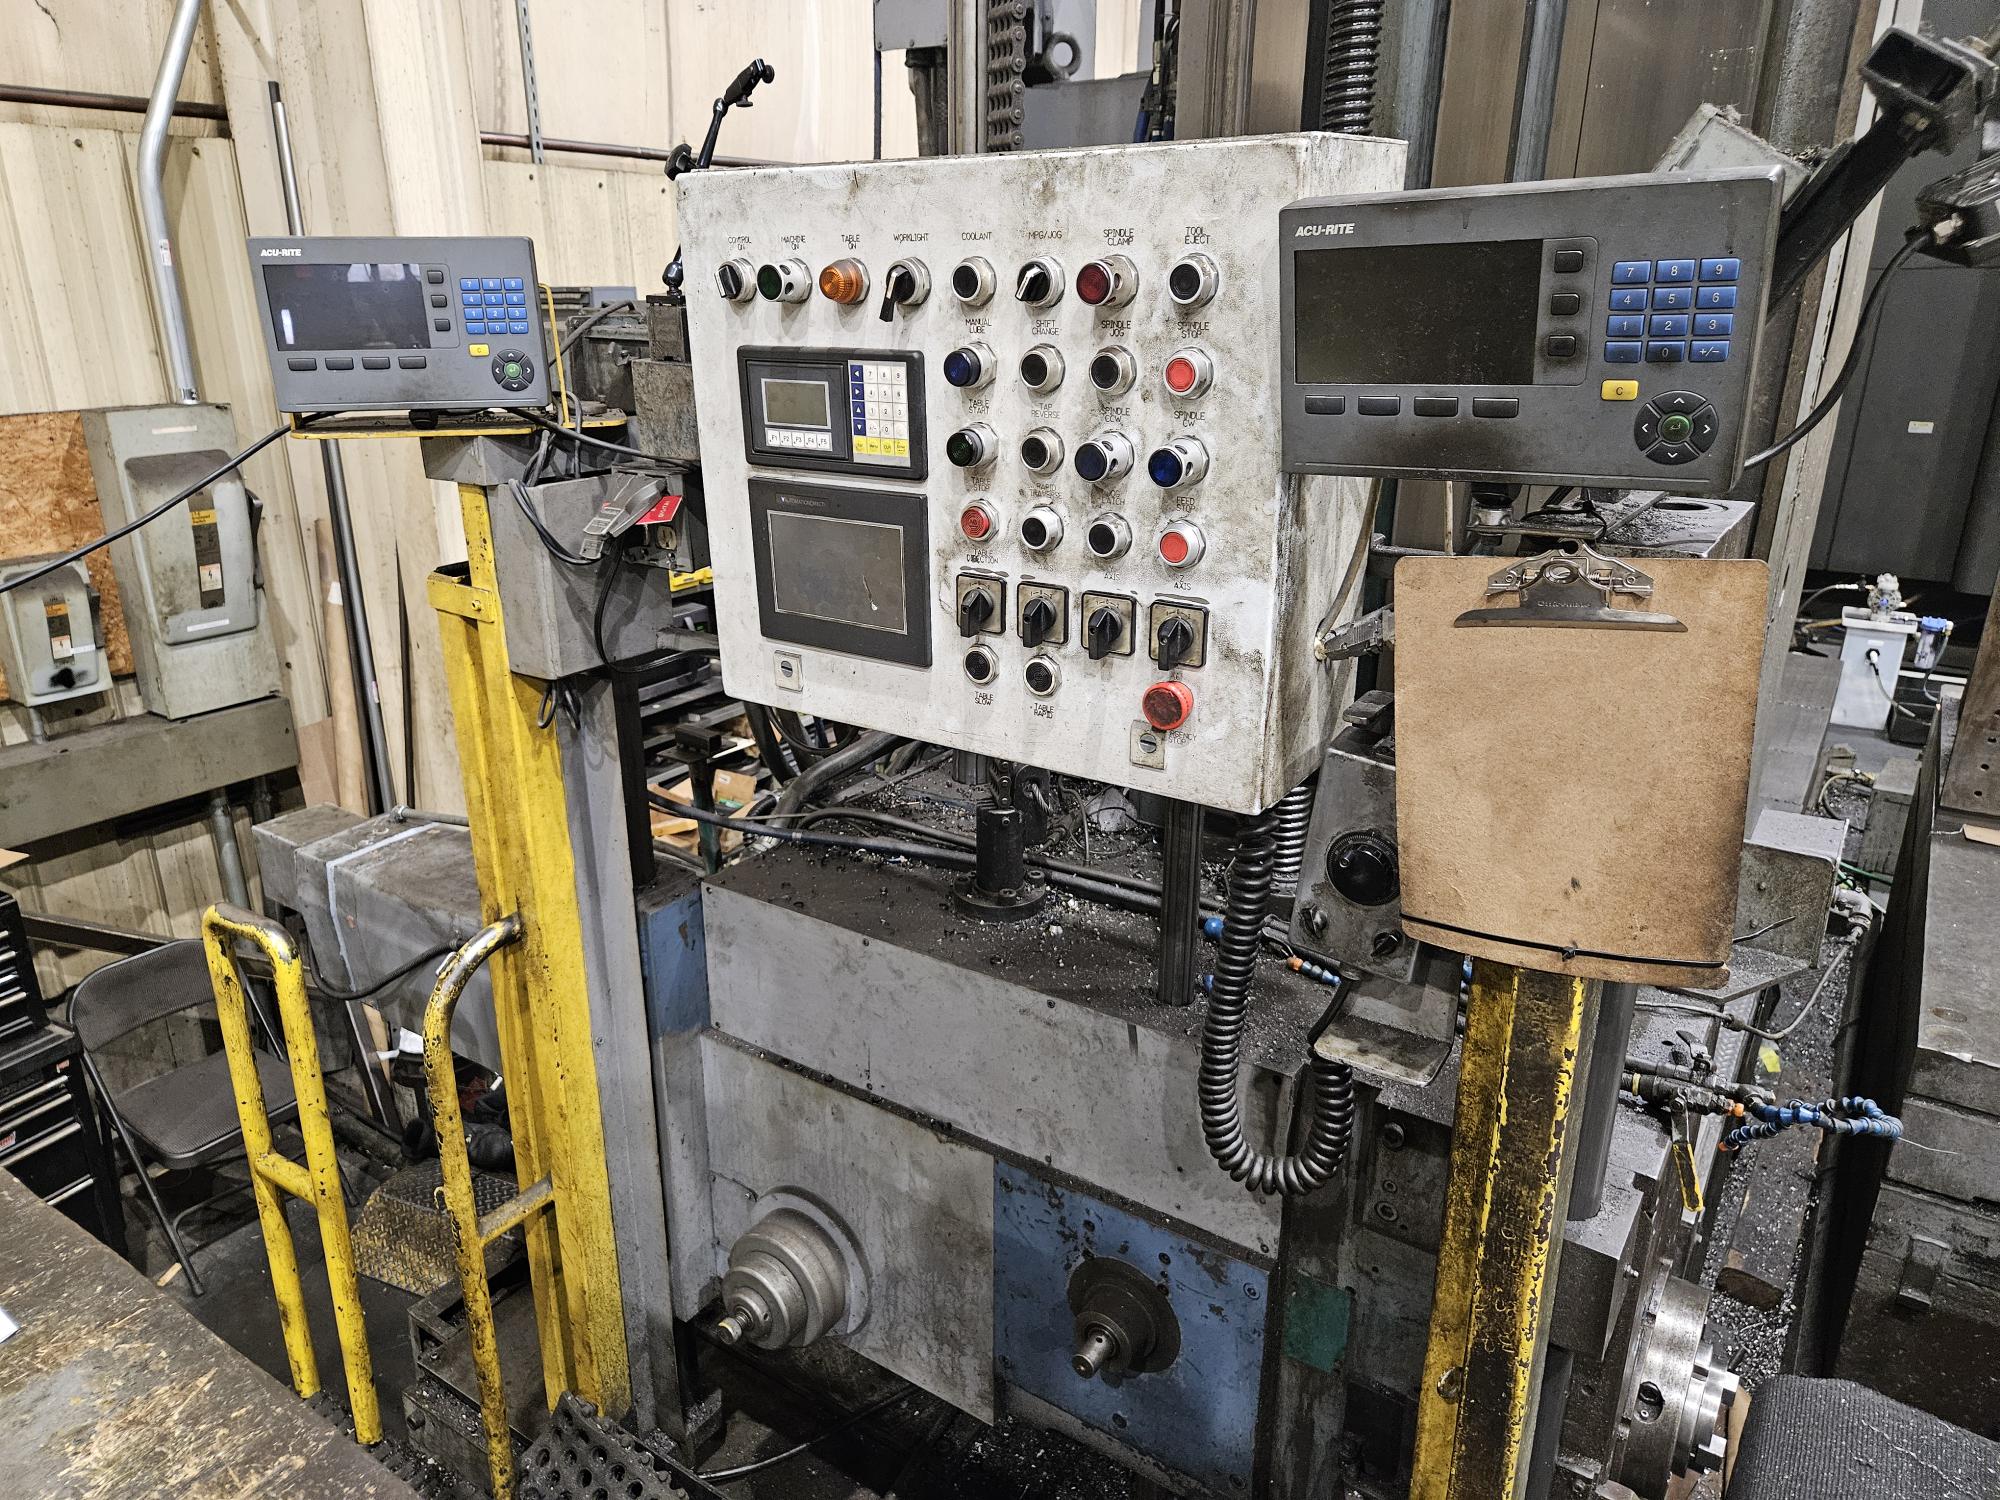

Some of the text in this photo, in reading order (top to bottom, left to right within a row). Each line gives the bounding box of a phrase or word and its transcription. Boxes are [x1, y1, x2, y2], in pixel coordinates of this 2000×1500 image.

[1103, 228, 1134, 238] SPINDLE
[1185, 227, 1206, 236] TOOL
[1295, 222, 1355, 237] ACU-RITE
[841, 234, 860, 242] TABLE
[894, 233, 928, 242] WORKLIGHT
[962, 232, 992, 240] COOLANT
[1028, 230, 1062, 240] MPG/JOG
[1184, 235, 1210, 244] EJECT
[1108, 236, 1134, 246] CLAMP
[261, 248, 301, 256] ACU-RITE
[1627, 264, 1722, 278] 7 8 9
[1624, 292, 1720, 304] 4 5 6
[966, 318, 992, 326] MANUAL
[1036, 320, 1056, 328] SHIFT
[1101, 320, 1131, 329] SPINDLE
[1178, 322, 1210, 330] SPINDLE
[1622, 320, 1716, 330] 1 2 3
[1032, 328, 1060, 336] CHANGE
[1110, 328, 1124, 337] JOG
[1182, 330, 1202, 338] STOP
[1662, 348, 1668, 357] 0
[1616, 387, 1623, 396] C
[969, 399, 989, 407] TABLE
[969, 406, 990, 414] START
[1032, 410, 1060, 418] REVERSE
[1102, 407, 1130, 416] SPINDLE
[1174, 411, 1205, 420] SPINDLE
[971, 476, 991, 484] TABLE
[1176, 496, 1194, 505] FEED
[1177, 504, 1196, 513] STOP
[1174, 582, 1192, 590] AXIS
[975, 692, 994, 700] TABLE
[1034, 703, 1054, 711] TABLE
